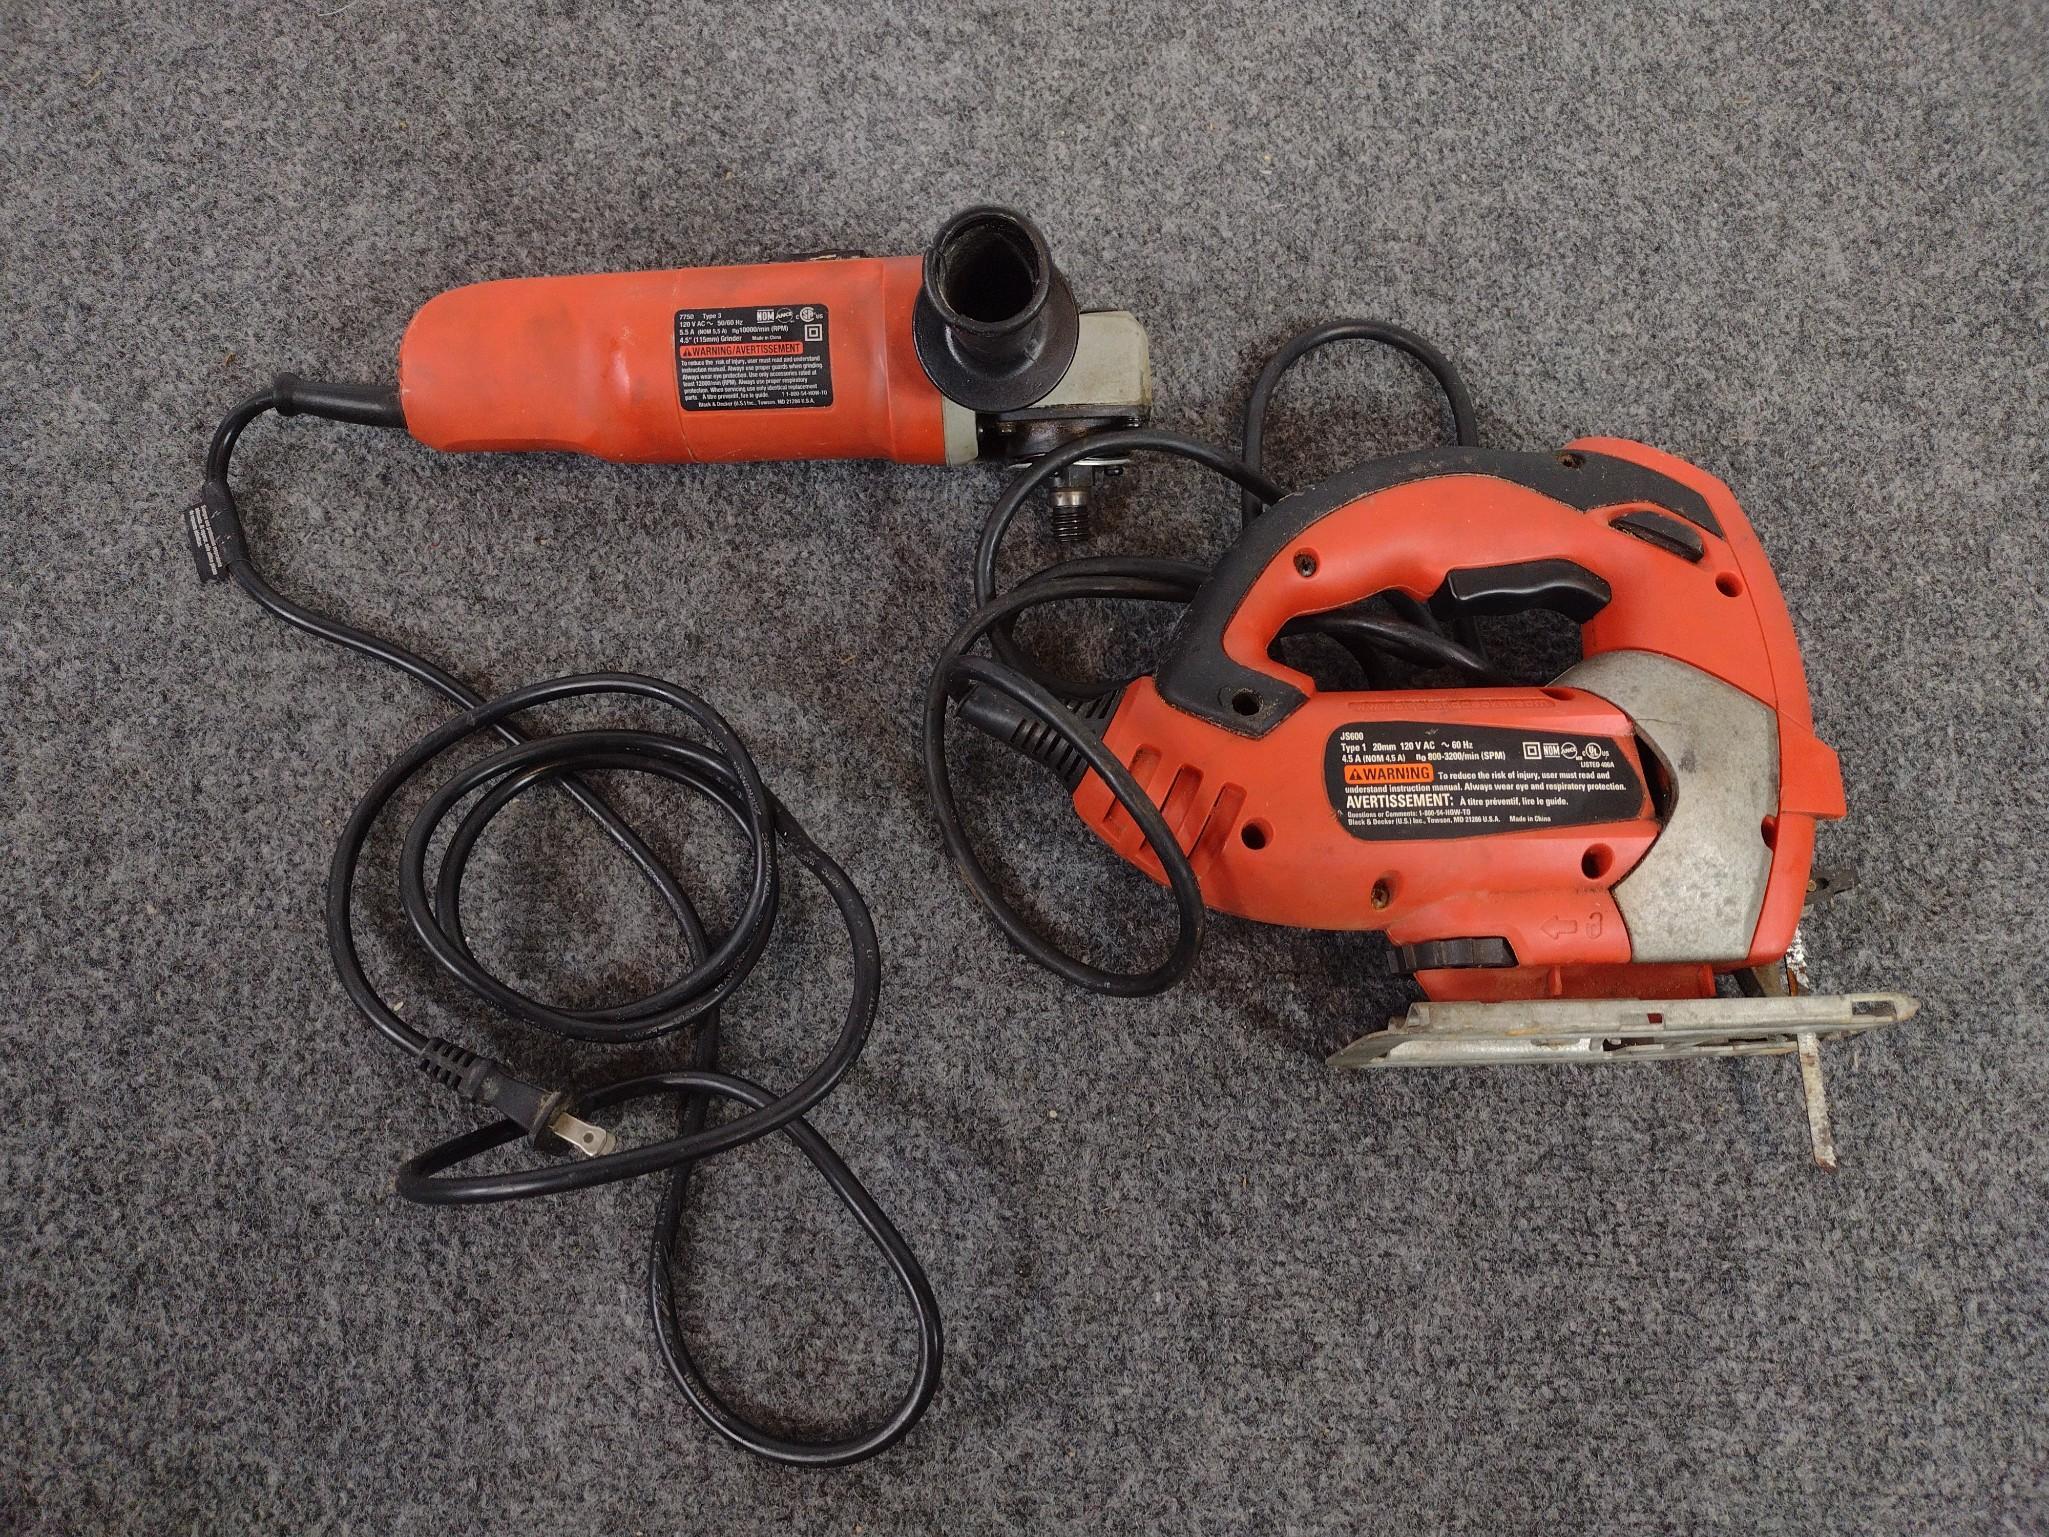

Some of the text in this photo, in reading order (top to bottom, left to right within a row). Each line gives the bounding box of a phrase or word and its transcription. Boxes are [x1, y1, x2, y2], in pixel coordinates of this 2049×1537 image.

[771, 325, 789, 333] (RPM)
[693, 336, 719, 344] (115mm)
[692, 344, 801, 356] WARNING/AVERTISSEMENT
[1340, 732, 1364, 741] JS600
[1341, 740, 1473, 753] Type 1 20mm 120 V AC 60 Hz
[1543, 745, 1560, 756] NOM
[1342, 754, 1354, 763] 4.5
[1354, 754, 1362, 763] A
[1363, 753, 1385, 764] (NOM
[1397, 753, 1406, 763] A)
[1427, 751, 1480, 761] 800-3200/min
[1481, 751, 1506, 761] (SPM)
[1362, 767, 1430, 781] WARNING
[1437, 771, 1449, 780] To
[1450, 771, 1477, 780] reduce
[1477, 771, 1490, 780] the
[1491, 771, 1506, 780] risk
[1507, 770, 1515, 779] of
[1516, 770, 1541, 781] injury,
[1559, 771, 1578, 779] must
[1578, 770, 1595, 779] read
[1596, 770, 1610, 779] and
[1345, 782, 1627, 794] understand instruction manual. Always wear eye and respiratory protection.
[1346, 793, 1454, 809] AVERTISSEMENT:
[1467, 797, 1483, 806] titre
[1485, 796, 1521, 807] préventif,
[1522, 796, 1536, 806] lire
[1536, 797, 1544, 806] le
[1545, 796, 1569, 807] guide.
[1347, 811, 1377, 819] Questions
[1385, 810, 1418, 818] Comments:
[1419, 808, 1471, 817] 1-800-54-HOW-TO
[1348, 818, 1366, 826] Black
[1372, 817, 1394, 825] Decker
[1395, 817, 1412, 825] (U.S.)
[1453, 816, 1464, 824] MD
[1482, 815, 1501, 823] U.S.A.
